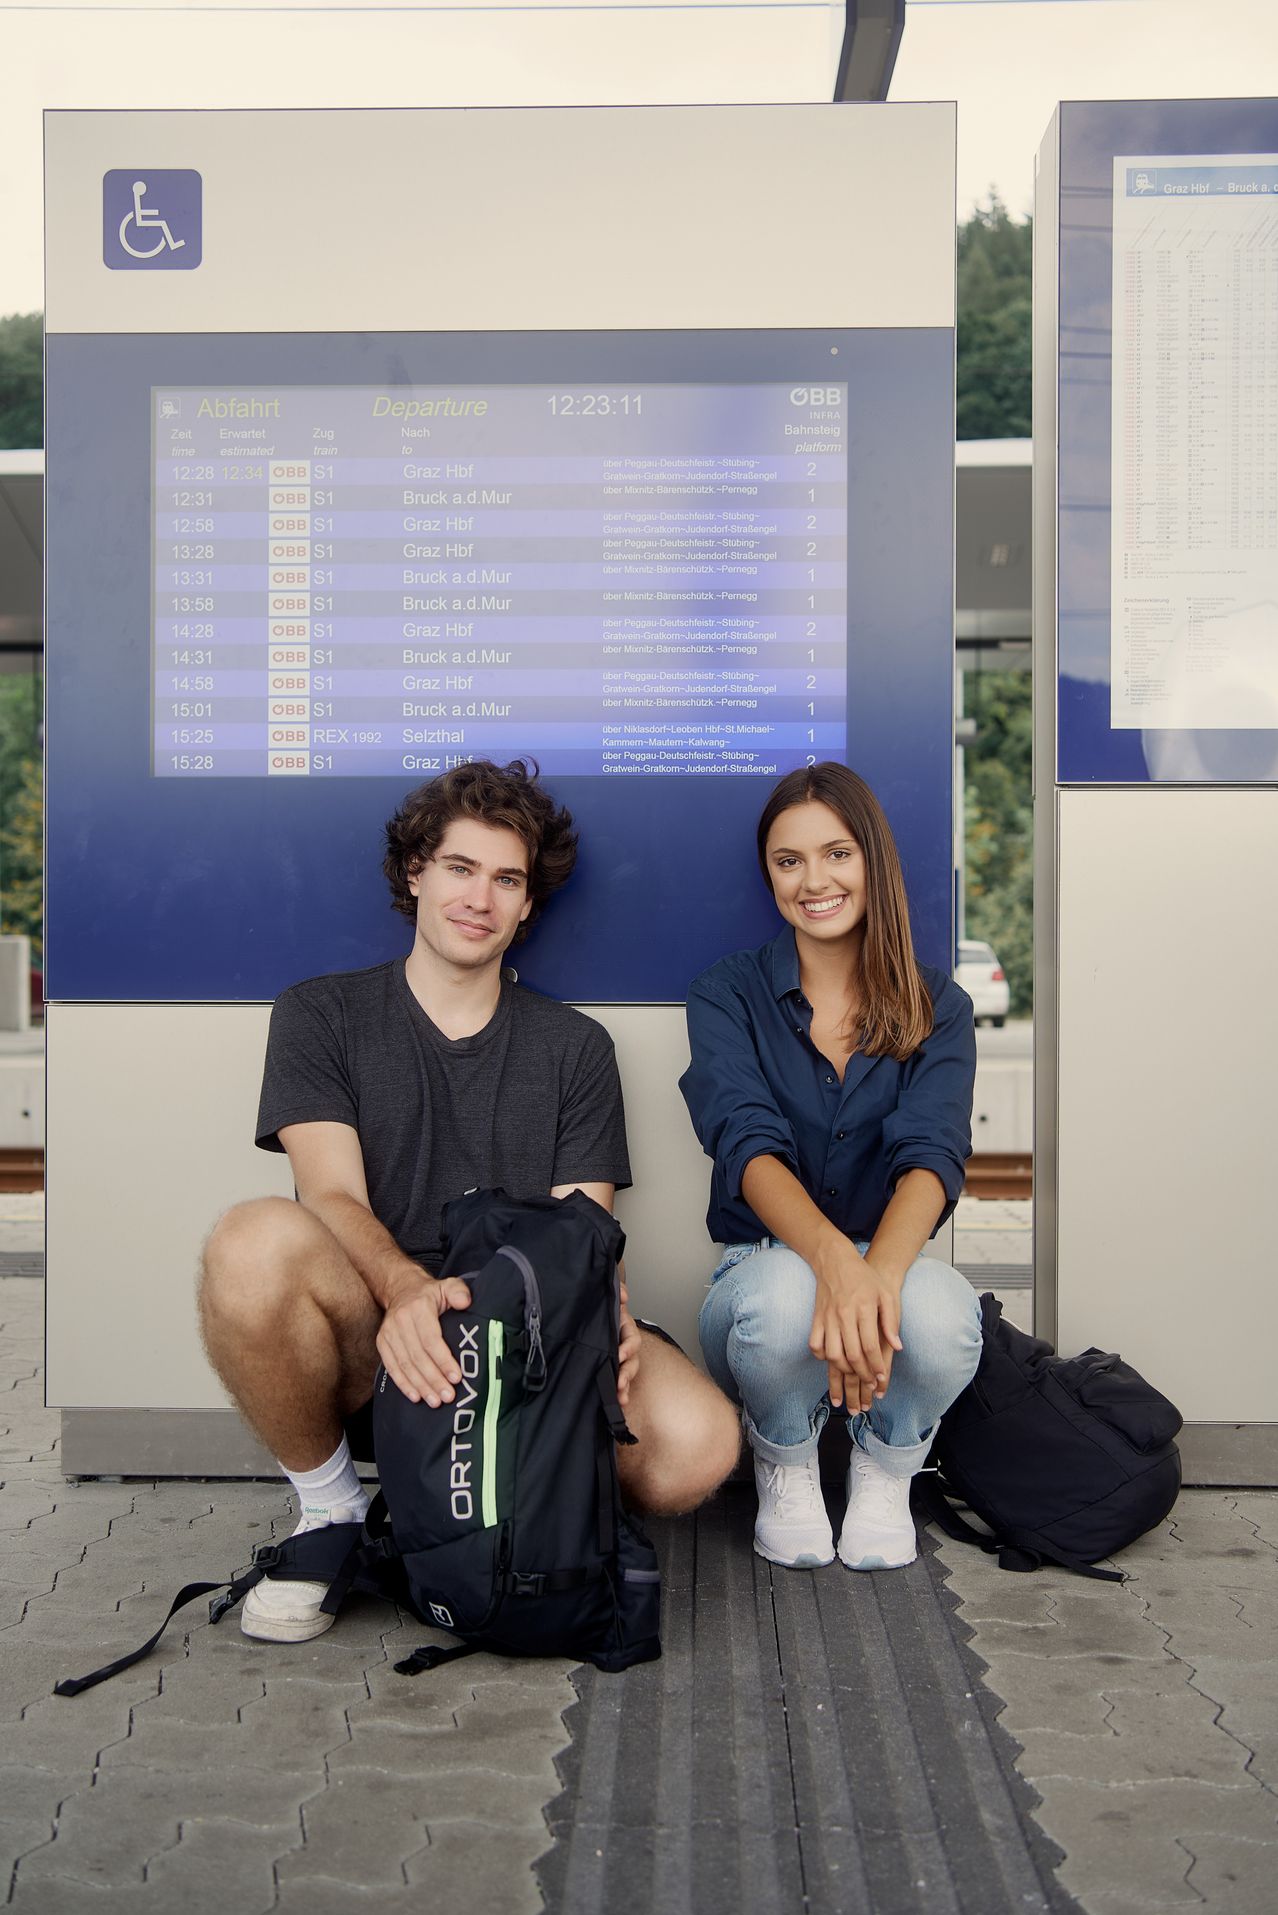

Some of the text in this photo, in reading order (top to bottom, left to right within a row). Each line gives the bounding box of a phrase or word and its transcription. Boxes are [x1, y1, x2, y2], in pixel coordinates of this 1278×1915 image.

[1163, 184, 1188, 194] Graz
[1191, 183, 1210, 194] Hbf
[1228, 182, 1259, 193] Bruck
[197, 398, 280, 418] Abfahrt
[372, 396, 488, 421] Departure
[548, 395, 642, 416] 12:23:11
[809, 410, 841, 420] INFRA
[170, 428, 192, 440] Zeit
[220, 428, 266, 439] Erwartet
[312, 428, 335, 441] Zug
[401, 427, 430, 438] Nach
[784, 424, 841, 437] Bahnsteig
[171, 446, 196, 457] time
[220, 446, 275, 456] estimated
[313, 446, 338, 456] train
[401, 444, 413, 456] to
[794, 441, 842, 454] platform
[603, 458, 622, 468] über
[807, 462, 817, 476] 2
[172, 466, 214, 480] 12:28
[221, 466, 264, 480] 12:34
[313, 465, 334, 479] S1
[403, 464, 474, 479] Graz Hbf
[603, 485, 622, 494] über
[808, 489, 815, 503] 1
[172, 492, 213, 506] 12:31
[313, 491, 334, 505] S1
[403, 491, 513, 505] Bruck a.d.Mur
[603, 512, 622, 521] über
[807, 515, 817, 529] 2
[172, 518, 214, 533] 12:58
[313, 518, 334, 532] S1
[403, 517, 474, 532] Graz Hbf
[603, 538, 622, 548] über
[807, 542, 817, 556] 2
[172, 545, 214, 559] 13:28
[313, 544, 334, 558] S1
[403, 543, 474, 558] Graz Hbf
[603, 565, 622, 574] über
[808, 568, 815, 582] 1
[172, 571, 213, 585] 13:31
[313, 570, 334, 584] S1
[403, 570, 513, 584] Bruck a.d.Mur
[403, 596, 513, 610] Bruck a.d.Mur
[603, 592, 622, 601] über
[808, 595, 815, 609] 1
[172, 597, 214, 612] 13:58
[313, 597, 334, 611] S1
[403, 622, 474, 637] Graz Hbf
[602, 618, 622, 627] über
[807, 622, 817, 635] 2
[171, 624, 213, 638] 14:28
[313, 623, 333, 637] S1
[313, 649, 333, 663] S1
[403, 649, 512, 663] Bruck a.d.Mur
[602, 645, 622, 654] über
[808, 648, 815, 662] 1
[171, 650, 212, 664] 14:31
[402, 675, 474, 690] Graz Hbf
[602, 671, 622, 680] über
[807, 675, 817, 688] 2
[171, 676, 213, 691] 14:58
[313, 676, 333, 690] S1
[312, 702, 333, 716] S1
[403, 702, 512, 716] Bruck a.d.Mur
[602, 698, 621, 707] über
[808, 701, 815, 715] 1
[171, 703, 212, 717] 15:01
[171, 729, 213, 743] 15:25
[313, 728, 382, 743] REX 1992
[402, 728, 464, 743] Selzthal
[602, 725, 622, 734] über
[624, 725, 702, 734] Niklasdorf~Leoben
[808, 728, 815, 741] 1
[171, 755, 213, 770] 15:28
[312, 755, 333, 769] S1
[402, 754, 440, 769] Graz
[602, 751, 621, 760] über
[450, 1323, 480, 1520] ORTOVOX
